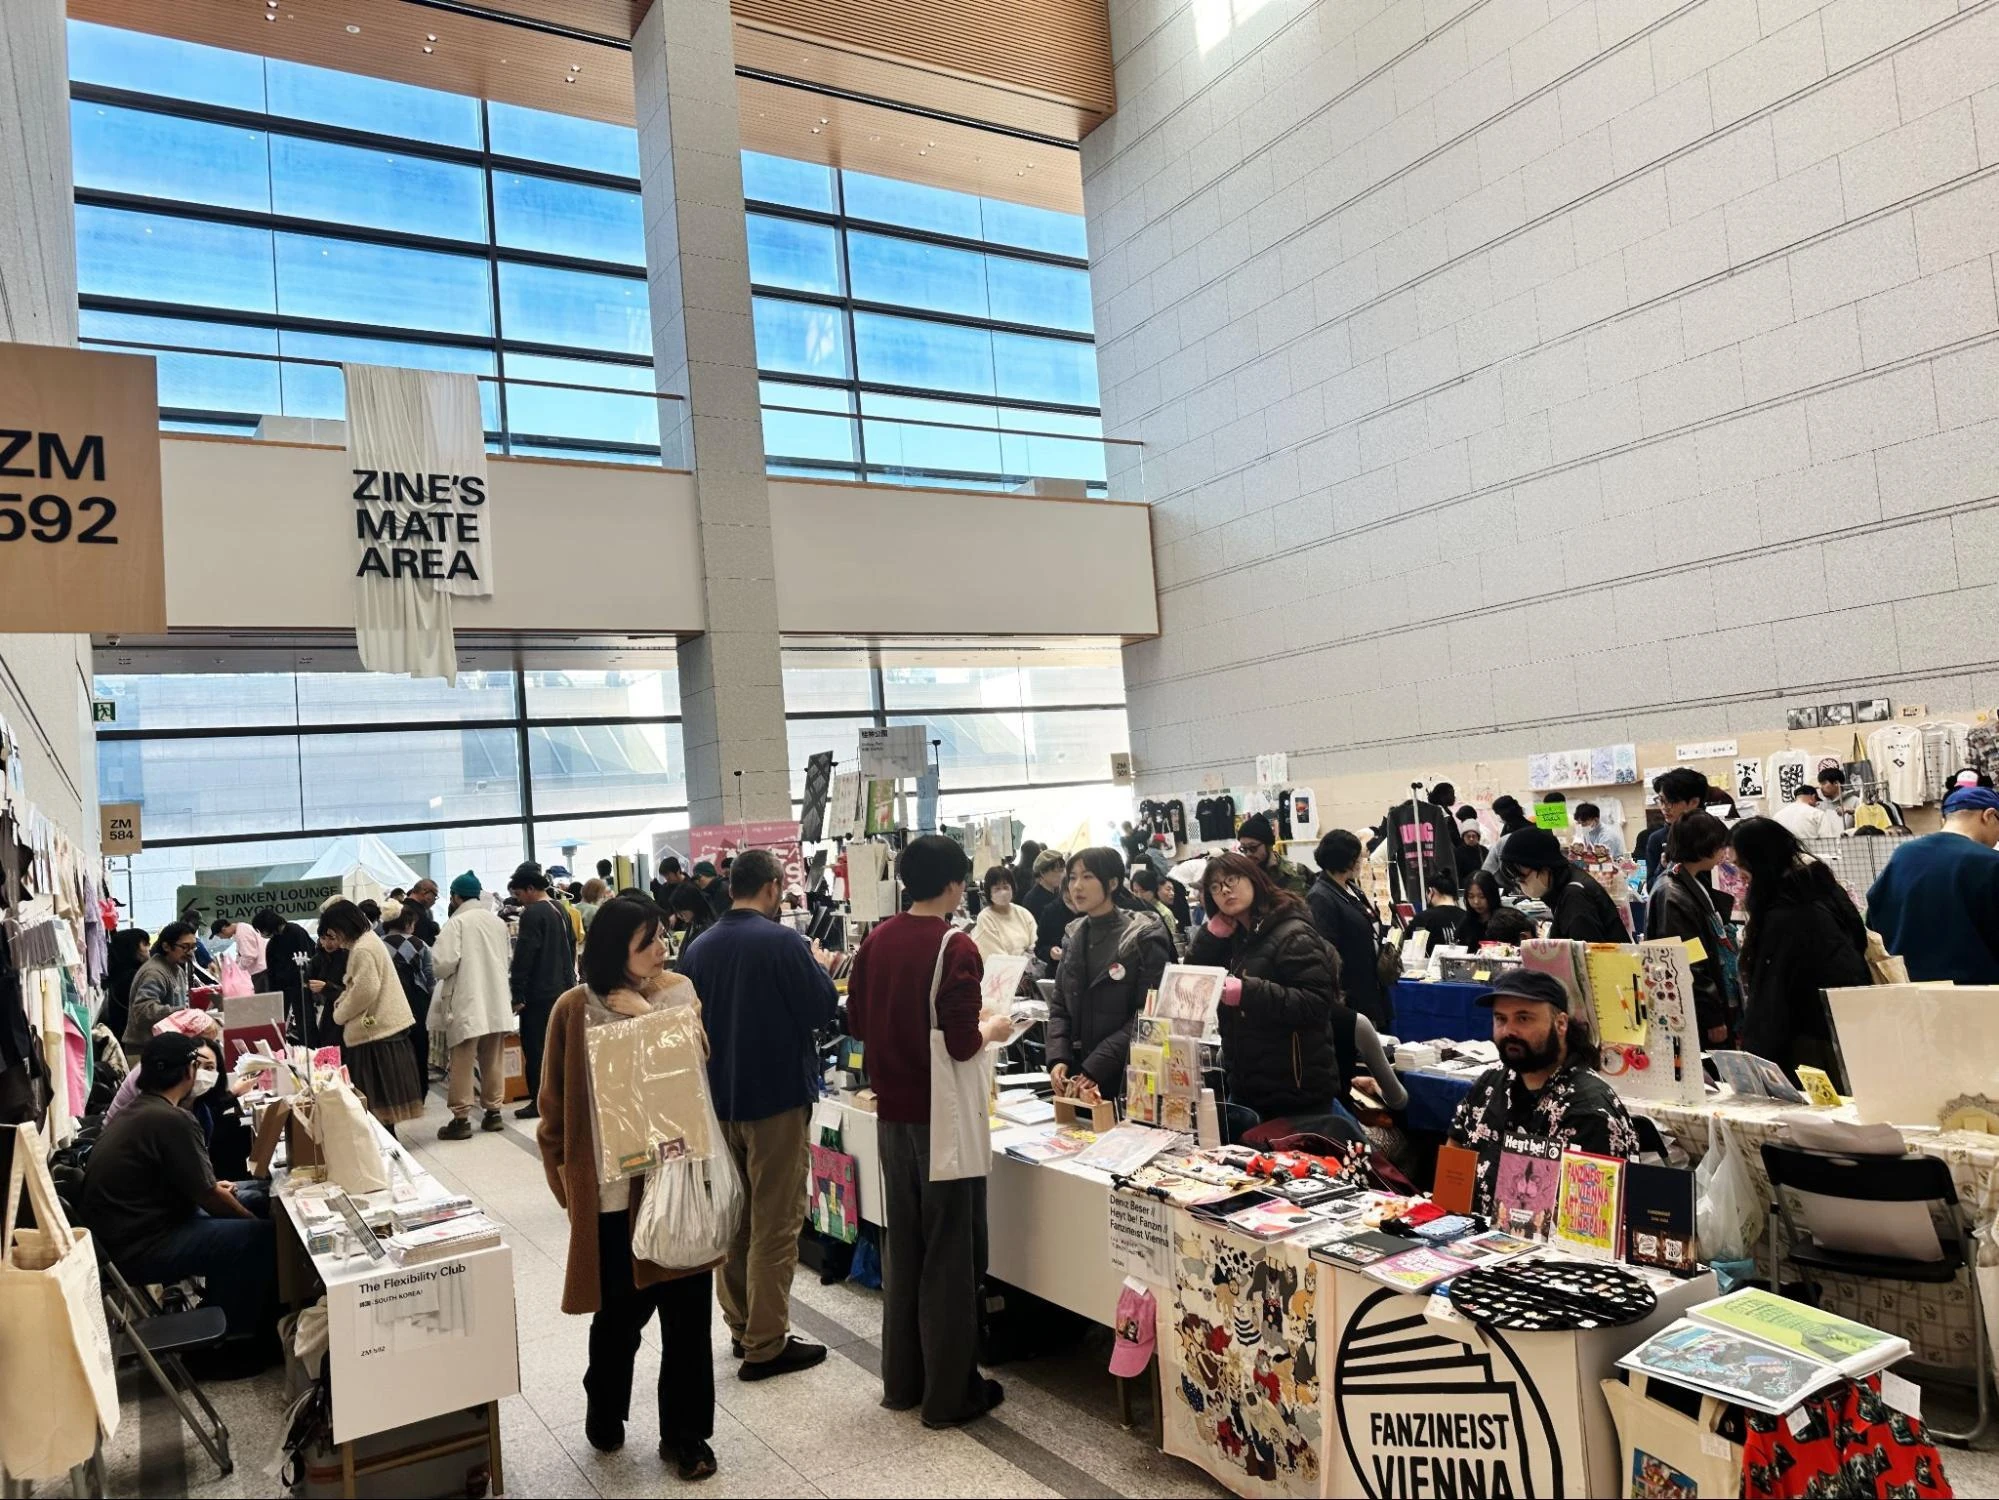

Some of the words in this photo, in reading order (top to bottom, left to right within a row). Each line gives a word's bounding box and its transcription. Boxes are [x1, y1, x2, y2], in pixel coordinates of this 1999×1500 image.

[0, 429, 105, 481] ZM
[353, 469, 486, 506] ZINE'S
[0, 493, 118, 544] 592
[356, 508, 480, 543] MATE
[356, 547, 480, 580] AREA
[109, 830, 134, 841] 584
[110, 818, 132, 829] ZM
[215, 891, 277, 907] SUNKEN
[280, 886, 338, 901] LOUNGE
[1110, 1194, 1129, 1208] Deniz
[1130, 1200, 1150, 1215] Beser
[1110, 1219, 1143, 1239] Fanzineist
[1144, 1230, 1169, 1247] Vienna
[1139, 1216, 1162, 1232] Fanzin
[359, 1283, 381, 1294] The
[384, 1270, 437, 1290] Flexibility
[440, 1263, 466, 1277] Club
[1370, 1412, 1510, 1450] FANZINEIST
[1372, 1454, 1514, 1498] VIENNA
